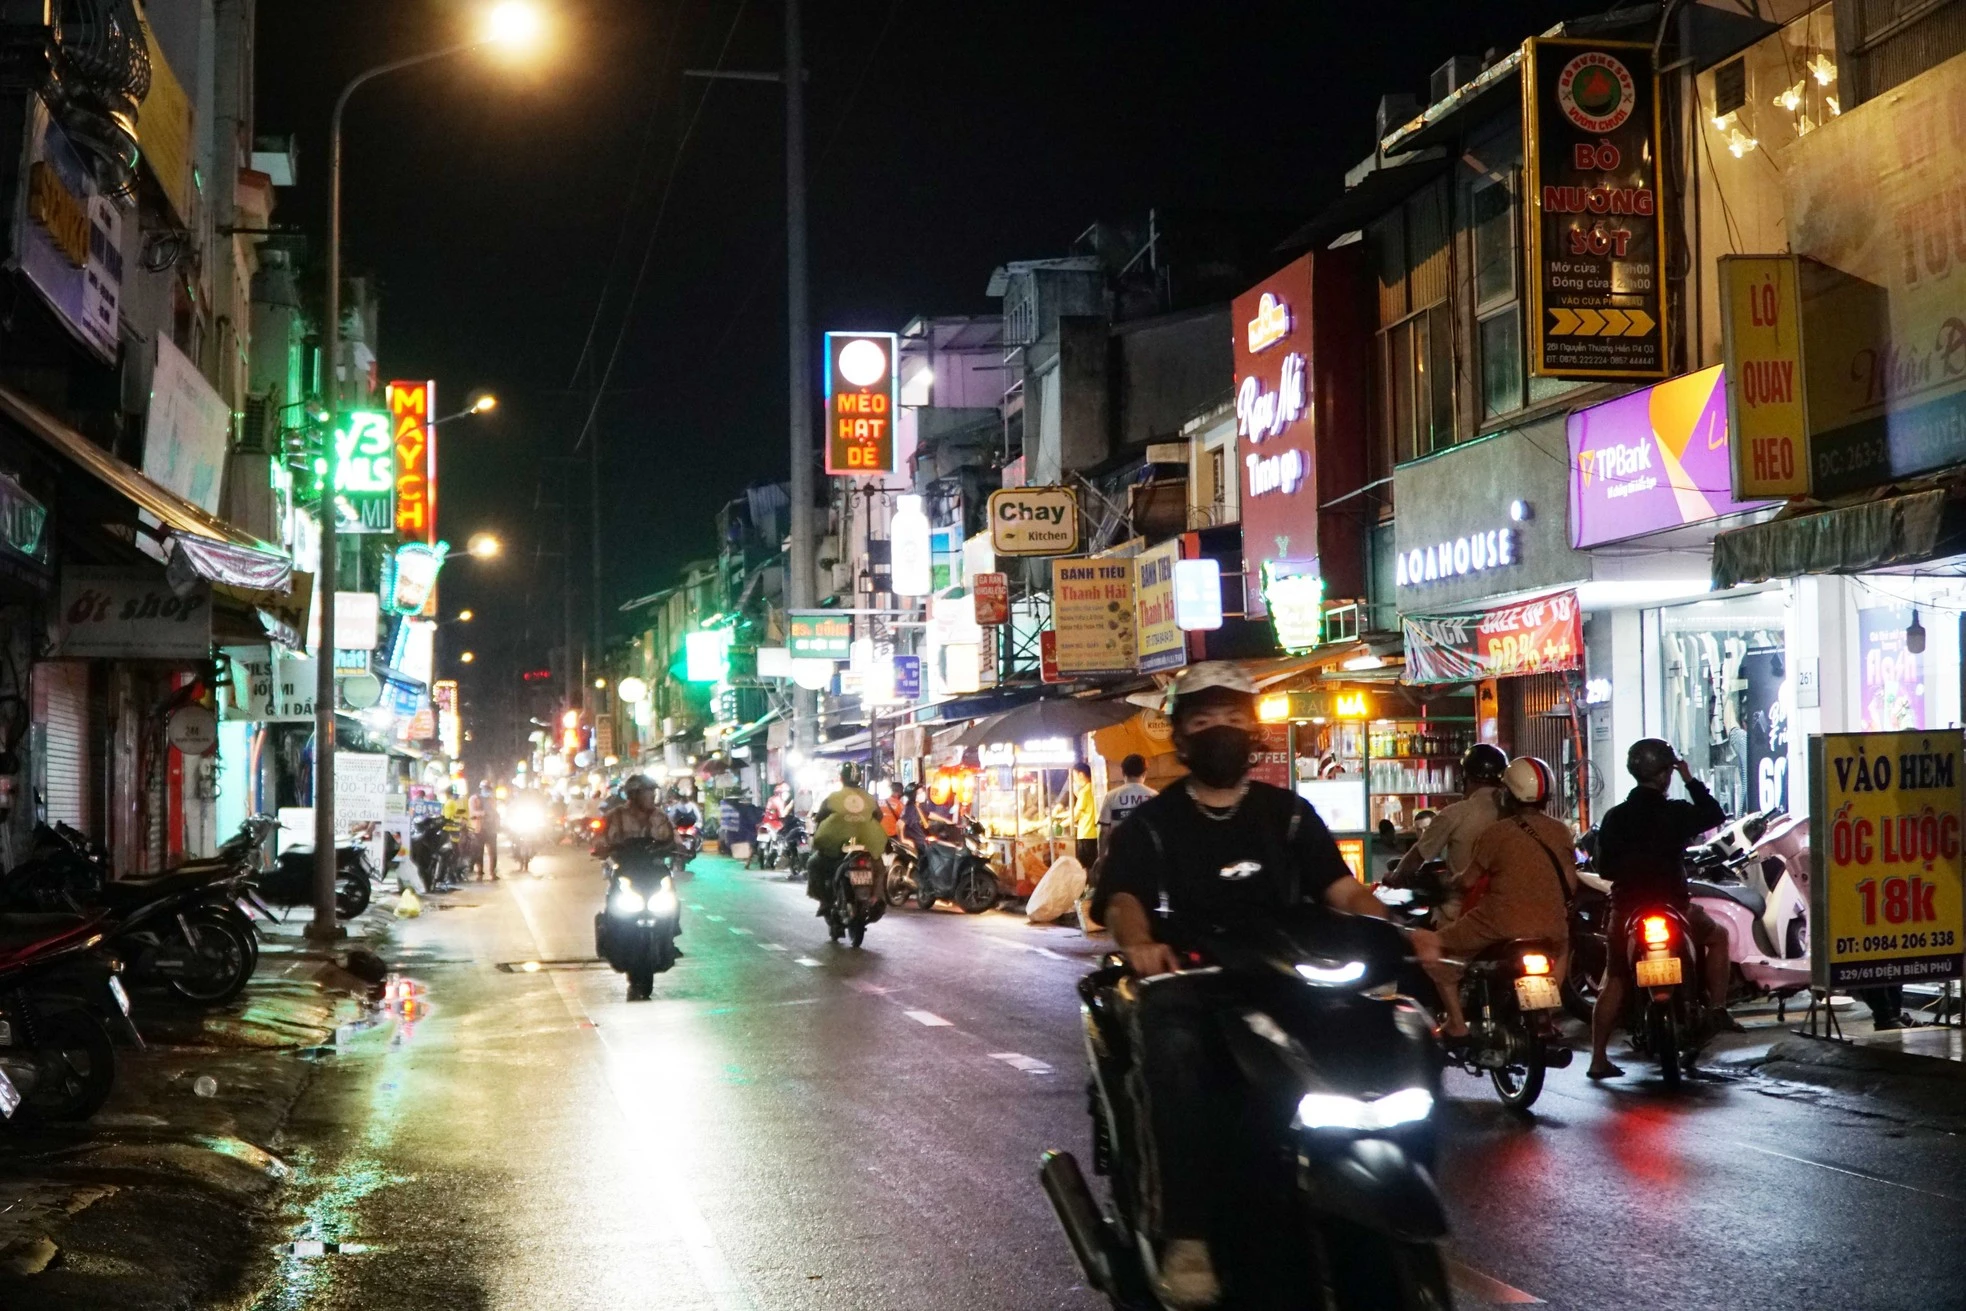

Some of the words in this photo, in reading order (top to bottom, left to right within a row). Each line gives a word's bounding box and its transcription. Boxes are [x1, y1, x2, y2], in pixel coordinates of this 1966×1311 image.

[1574, 139, 1621, 171] BÒ
[1543, 180, 1654, 216] NƯỚNG
[1570, 220, 1632, 256] SỐT
[1551, 262, 1571, 273] Mở
[1552, 276, 1584, 290] Đóng
[1751, 273, 1778, 327] LÒ
[1742, 360, 1794, 408] QUAY
[837, 389, 886, 413] MÈO
[839, 419, 884, 444] HẠT
[1595, 437, 1652, 482] TPBank
[1752, 436, 1795, 481] HEO
[999, 502, 1066, 524] Chay
[1028, 531, 1068, 542] Kitchen
[1061, 586, 1100, 601] Thanh
[1521, 599, 1545, 627] UP
[1550, 596, 1571, 622] TO
[1800, 672, 1814, 685] 261
[1296, 699, 1331, 714] RAU
[1834, 746, 1891, 793] VÀO
[1898, 738, 1956, 790] HẺM
[1832, 802, 1874, 867] ỐC
[1881, 805, 1961, 872] LUỘC
[1857, 875, 1937, 926] 18k
[1836, 938, 1860, 955] ĐT:
[1863, 935, 1898, 952] 0984
[1901, 932, 1927, 950] 206
[1930, 930, 1955, 947] 338
[1839, 967, 1874, 981] 329/61
[1875, 963, 1901, 981] ĐIỆN
[1903, 961, 1929, 976] BIÊN
